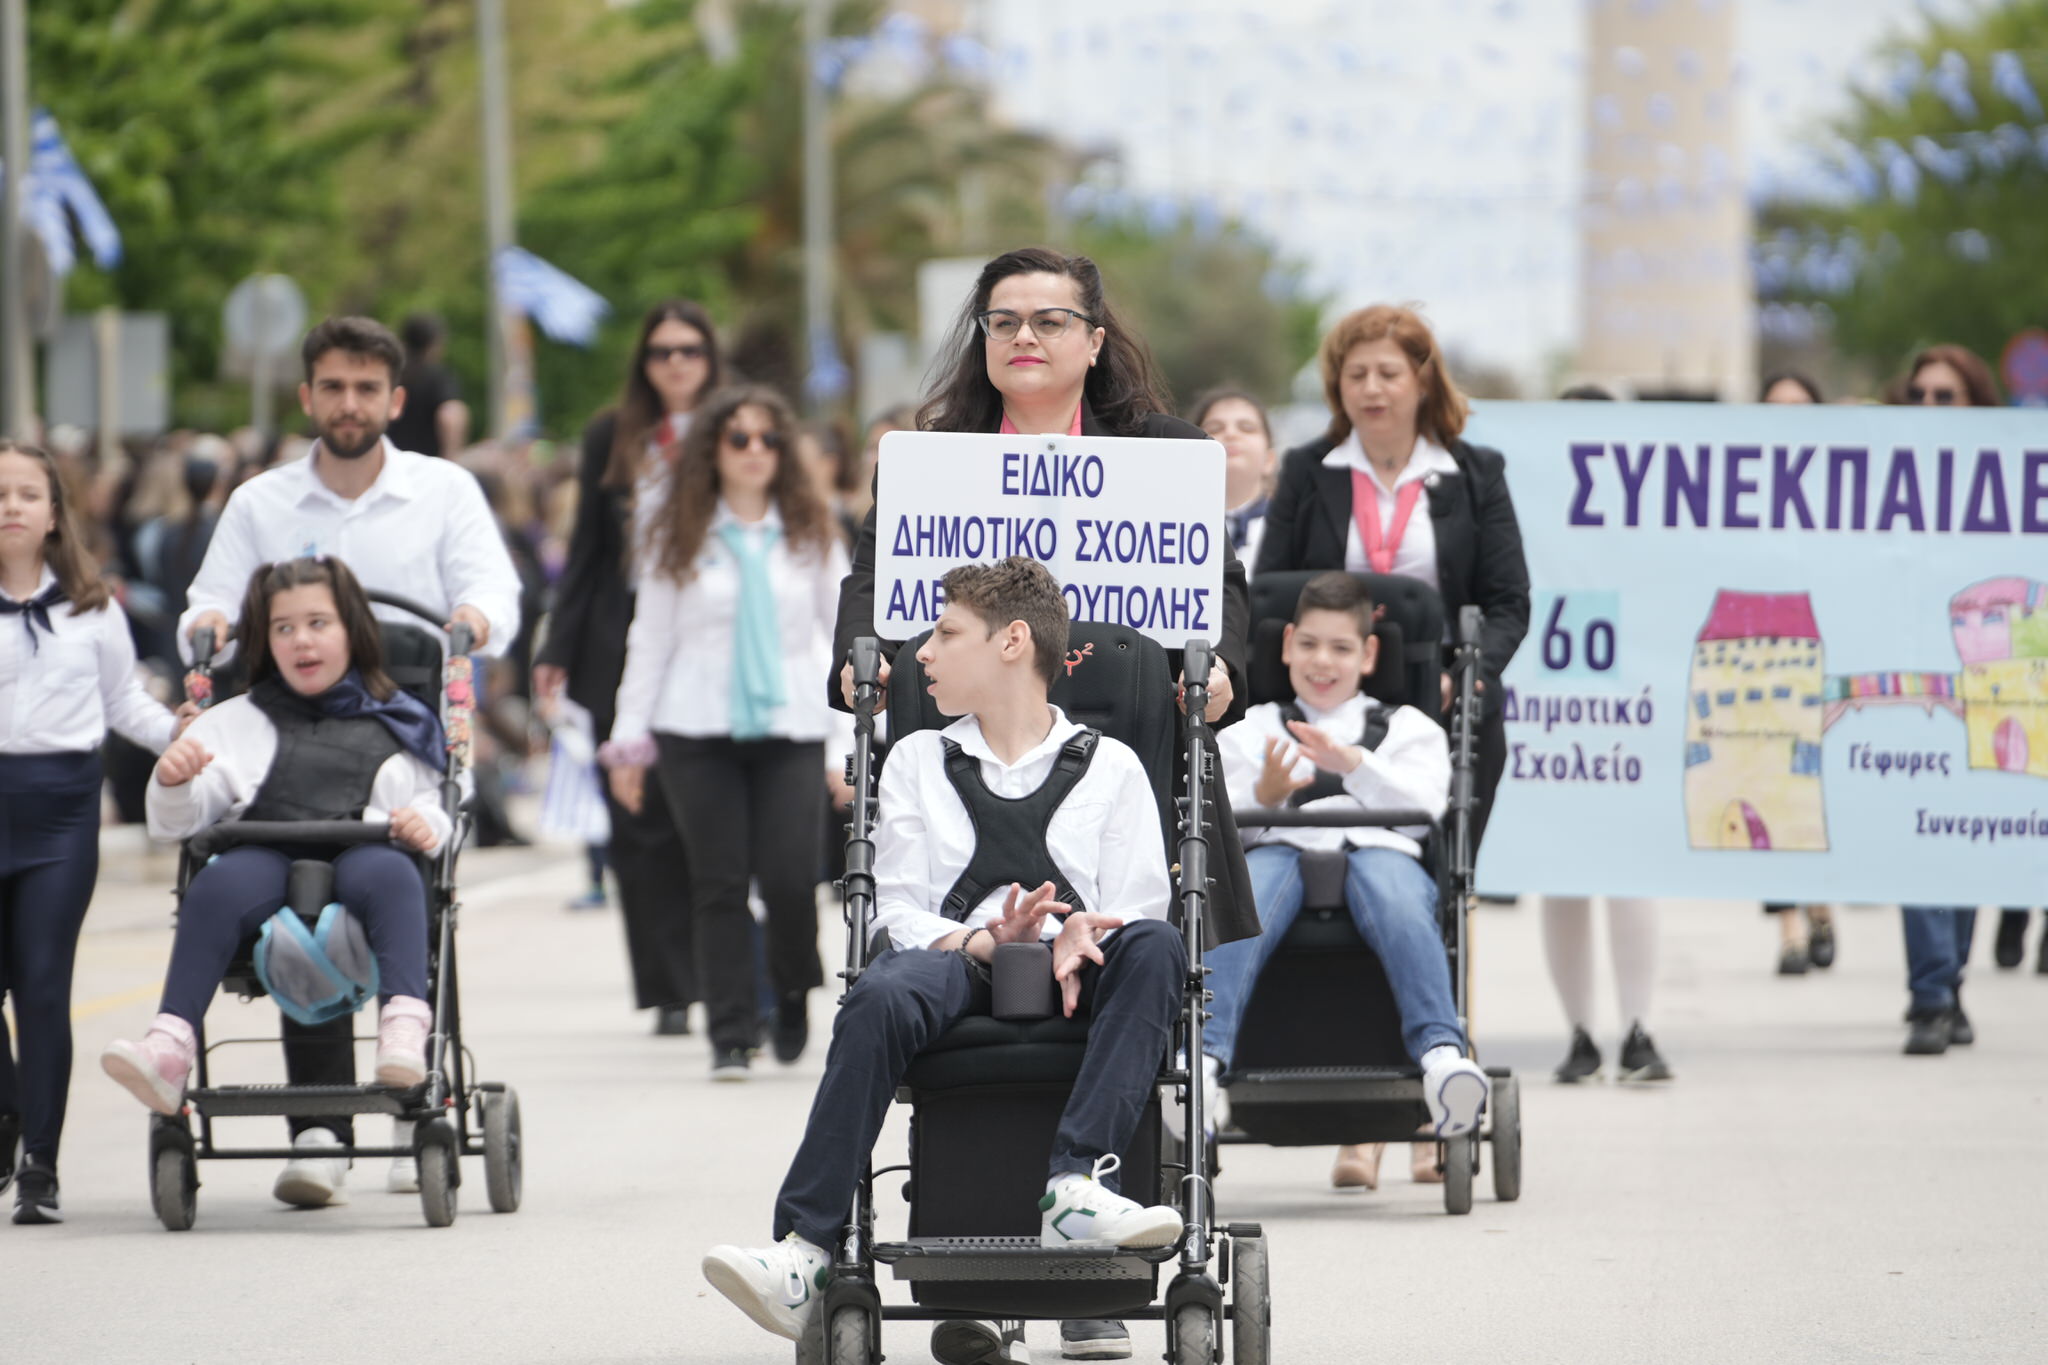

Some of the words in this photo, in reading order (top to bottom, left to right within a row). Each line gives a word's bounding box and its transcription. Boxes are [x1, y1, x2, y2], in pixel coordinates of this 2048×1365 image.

[1001, 452, 1105, 499] ΕΙΔΙΚΟ
[1567, 443, 2048, 535] ΣΥΝΕΚΠΑΙΔΕ
[891, 514, 1058, 562] ΔΗΜΟΤΙΚΟ
[1074, 518, 1210, 566] ΣΧΟΛΕΙΟ
[1503, 684, 1654, 733] Δημοτικό
[1510, 742, 1643, 783] Σχολείο
[1848, 742, 1951, 778] Γέφυρες
